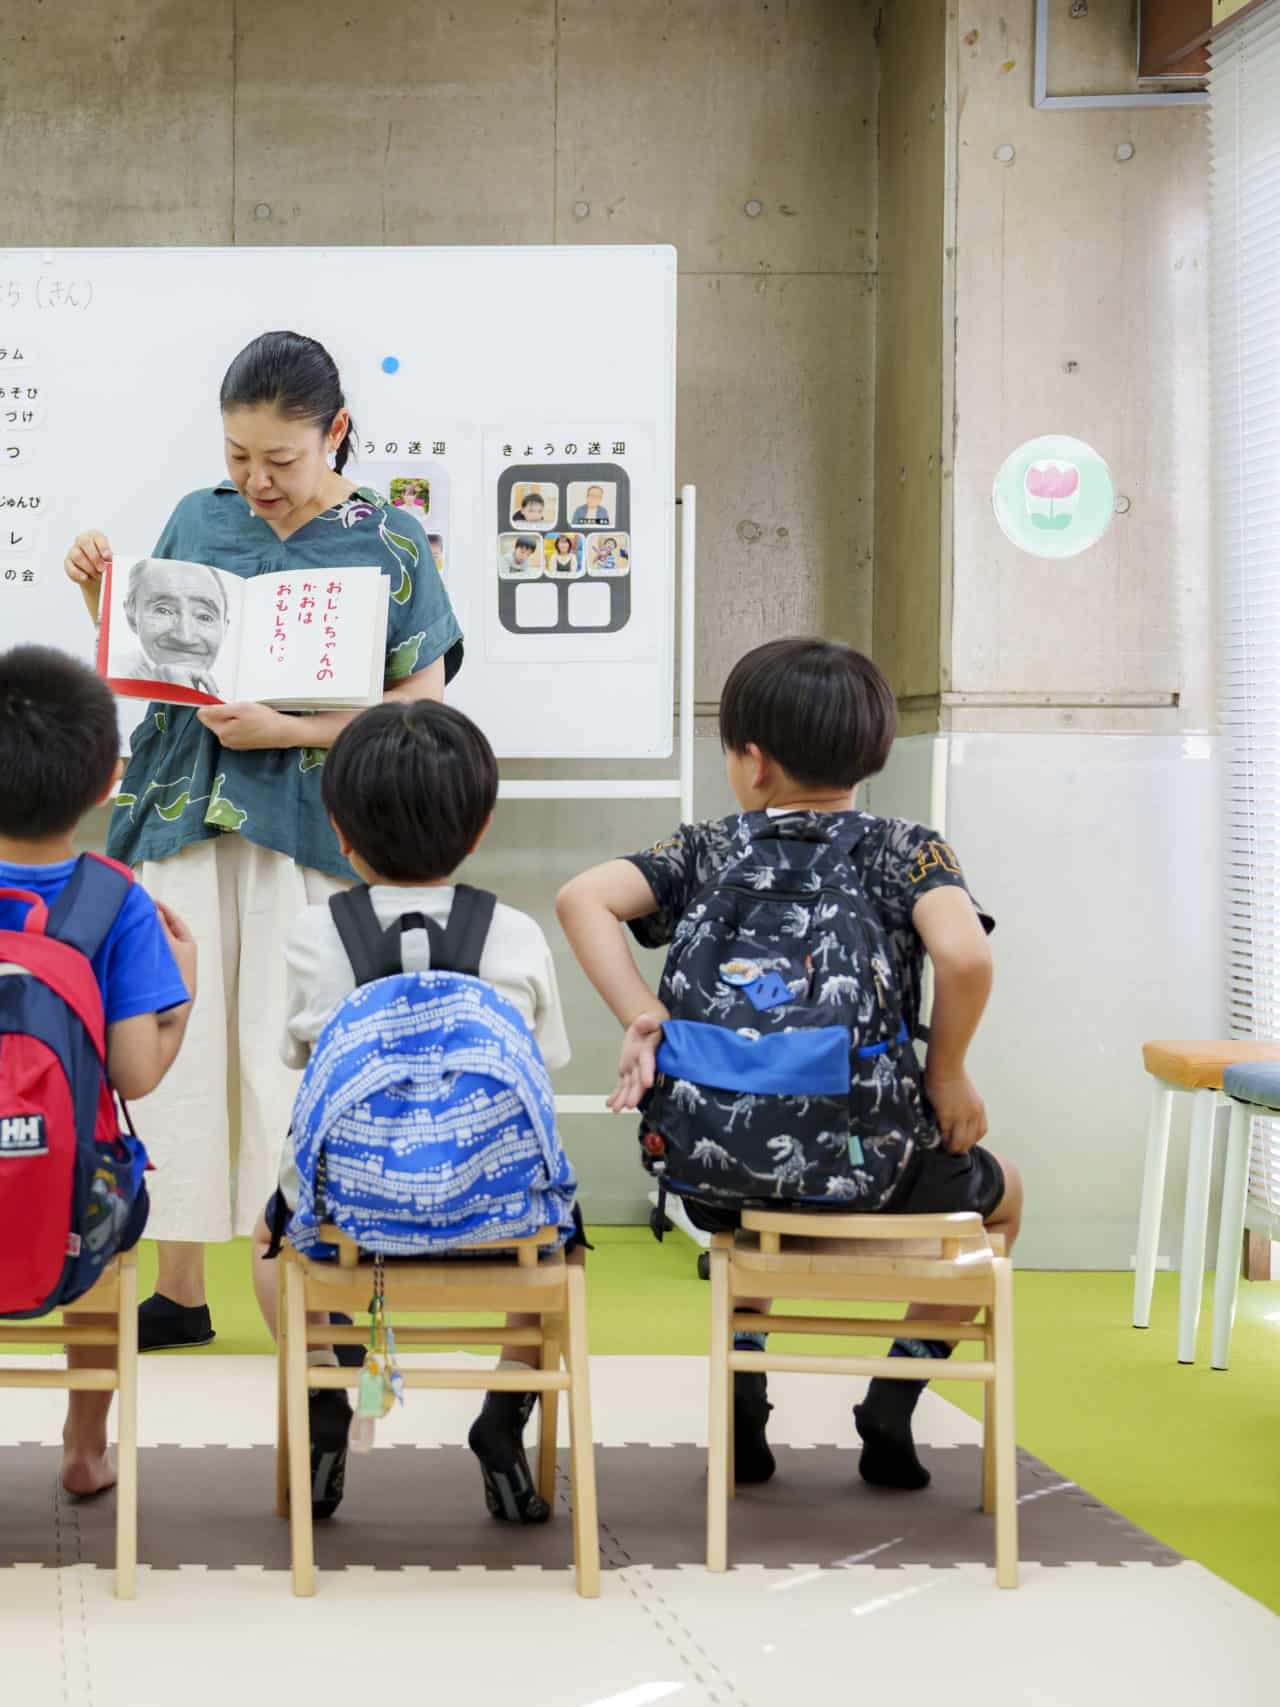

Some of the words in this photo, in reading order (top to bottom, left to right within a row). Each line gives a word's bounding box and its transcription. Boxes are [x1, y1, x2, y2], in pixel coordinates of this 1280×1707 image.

[502, 440, 626, 457] きょうの送迎
[297, 583, 317, 625] かおは
[0, 1116, 40, 1143] HH
